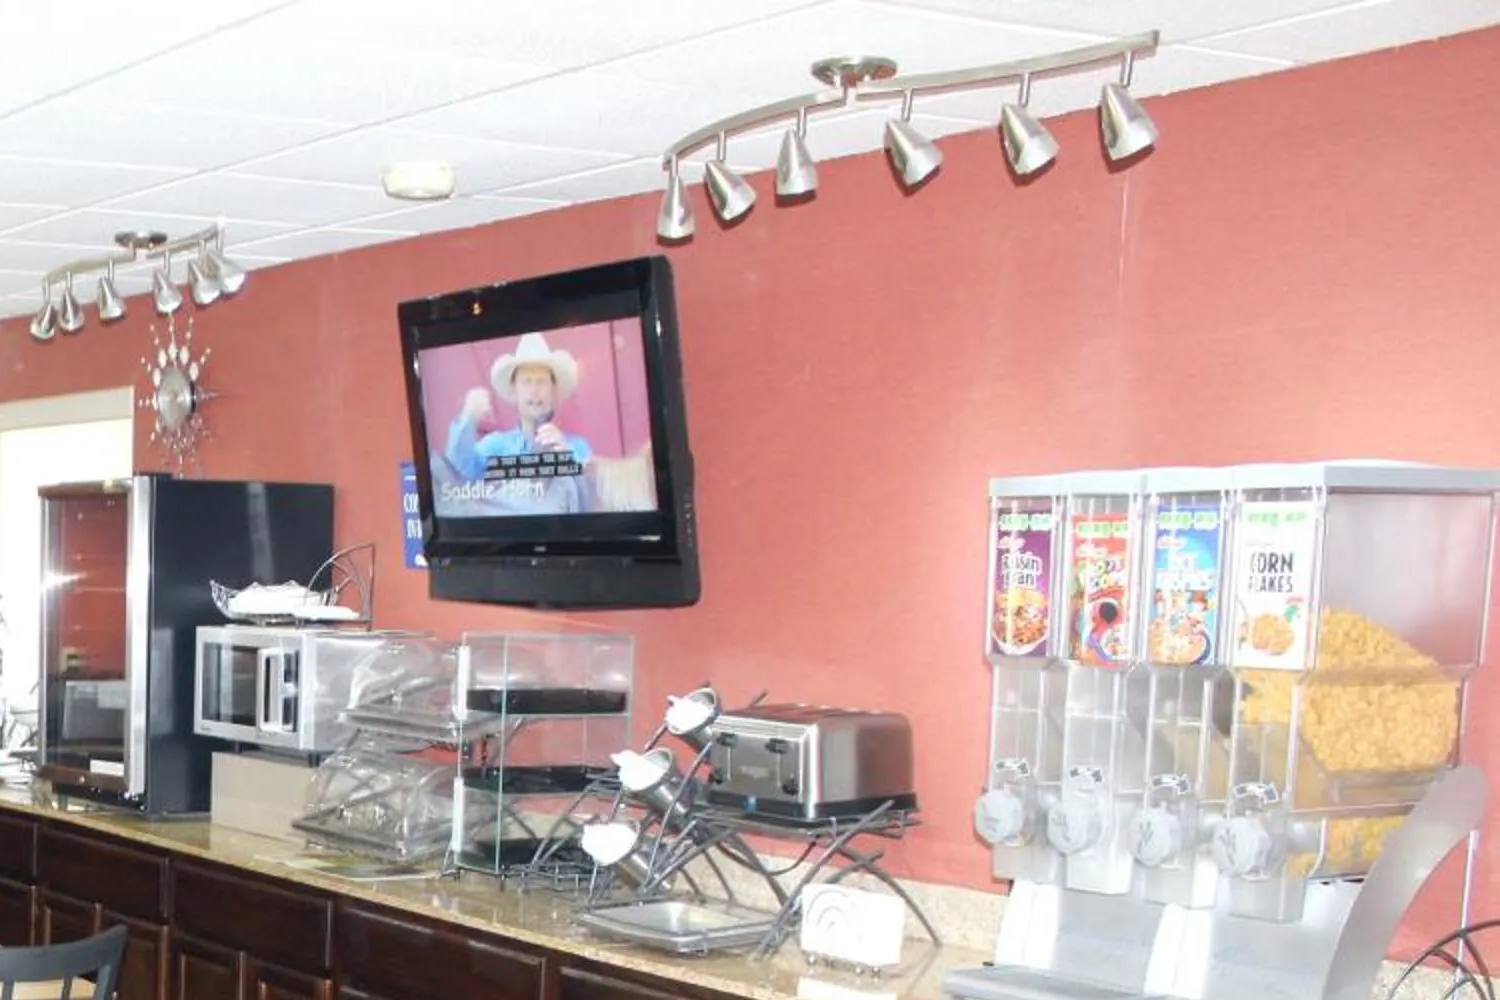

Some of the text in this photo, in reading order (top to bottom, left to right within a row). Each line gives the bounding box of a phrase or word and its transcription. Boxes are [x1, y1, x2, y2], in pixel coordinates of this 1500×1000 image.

[440, 479, 544, 501] Saddle Horn
[1250, 552, 1293, 574] CORN
[1248, 575, 1293, 593] FLAKES
